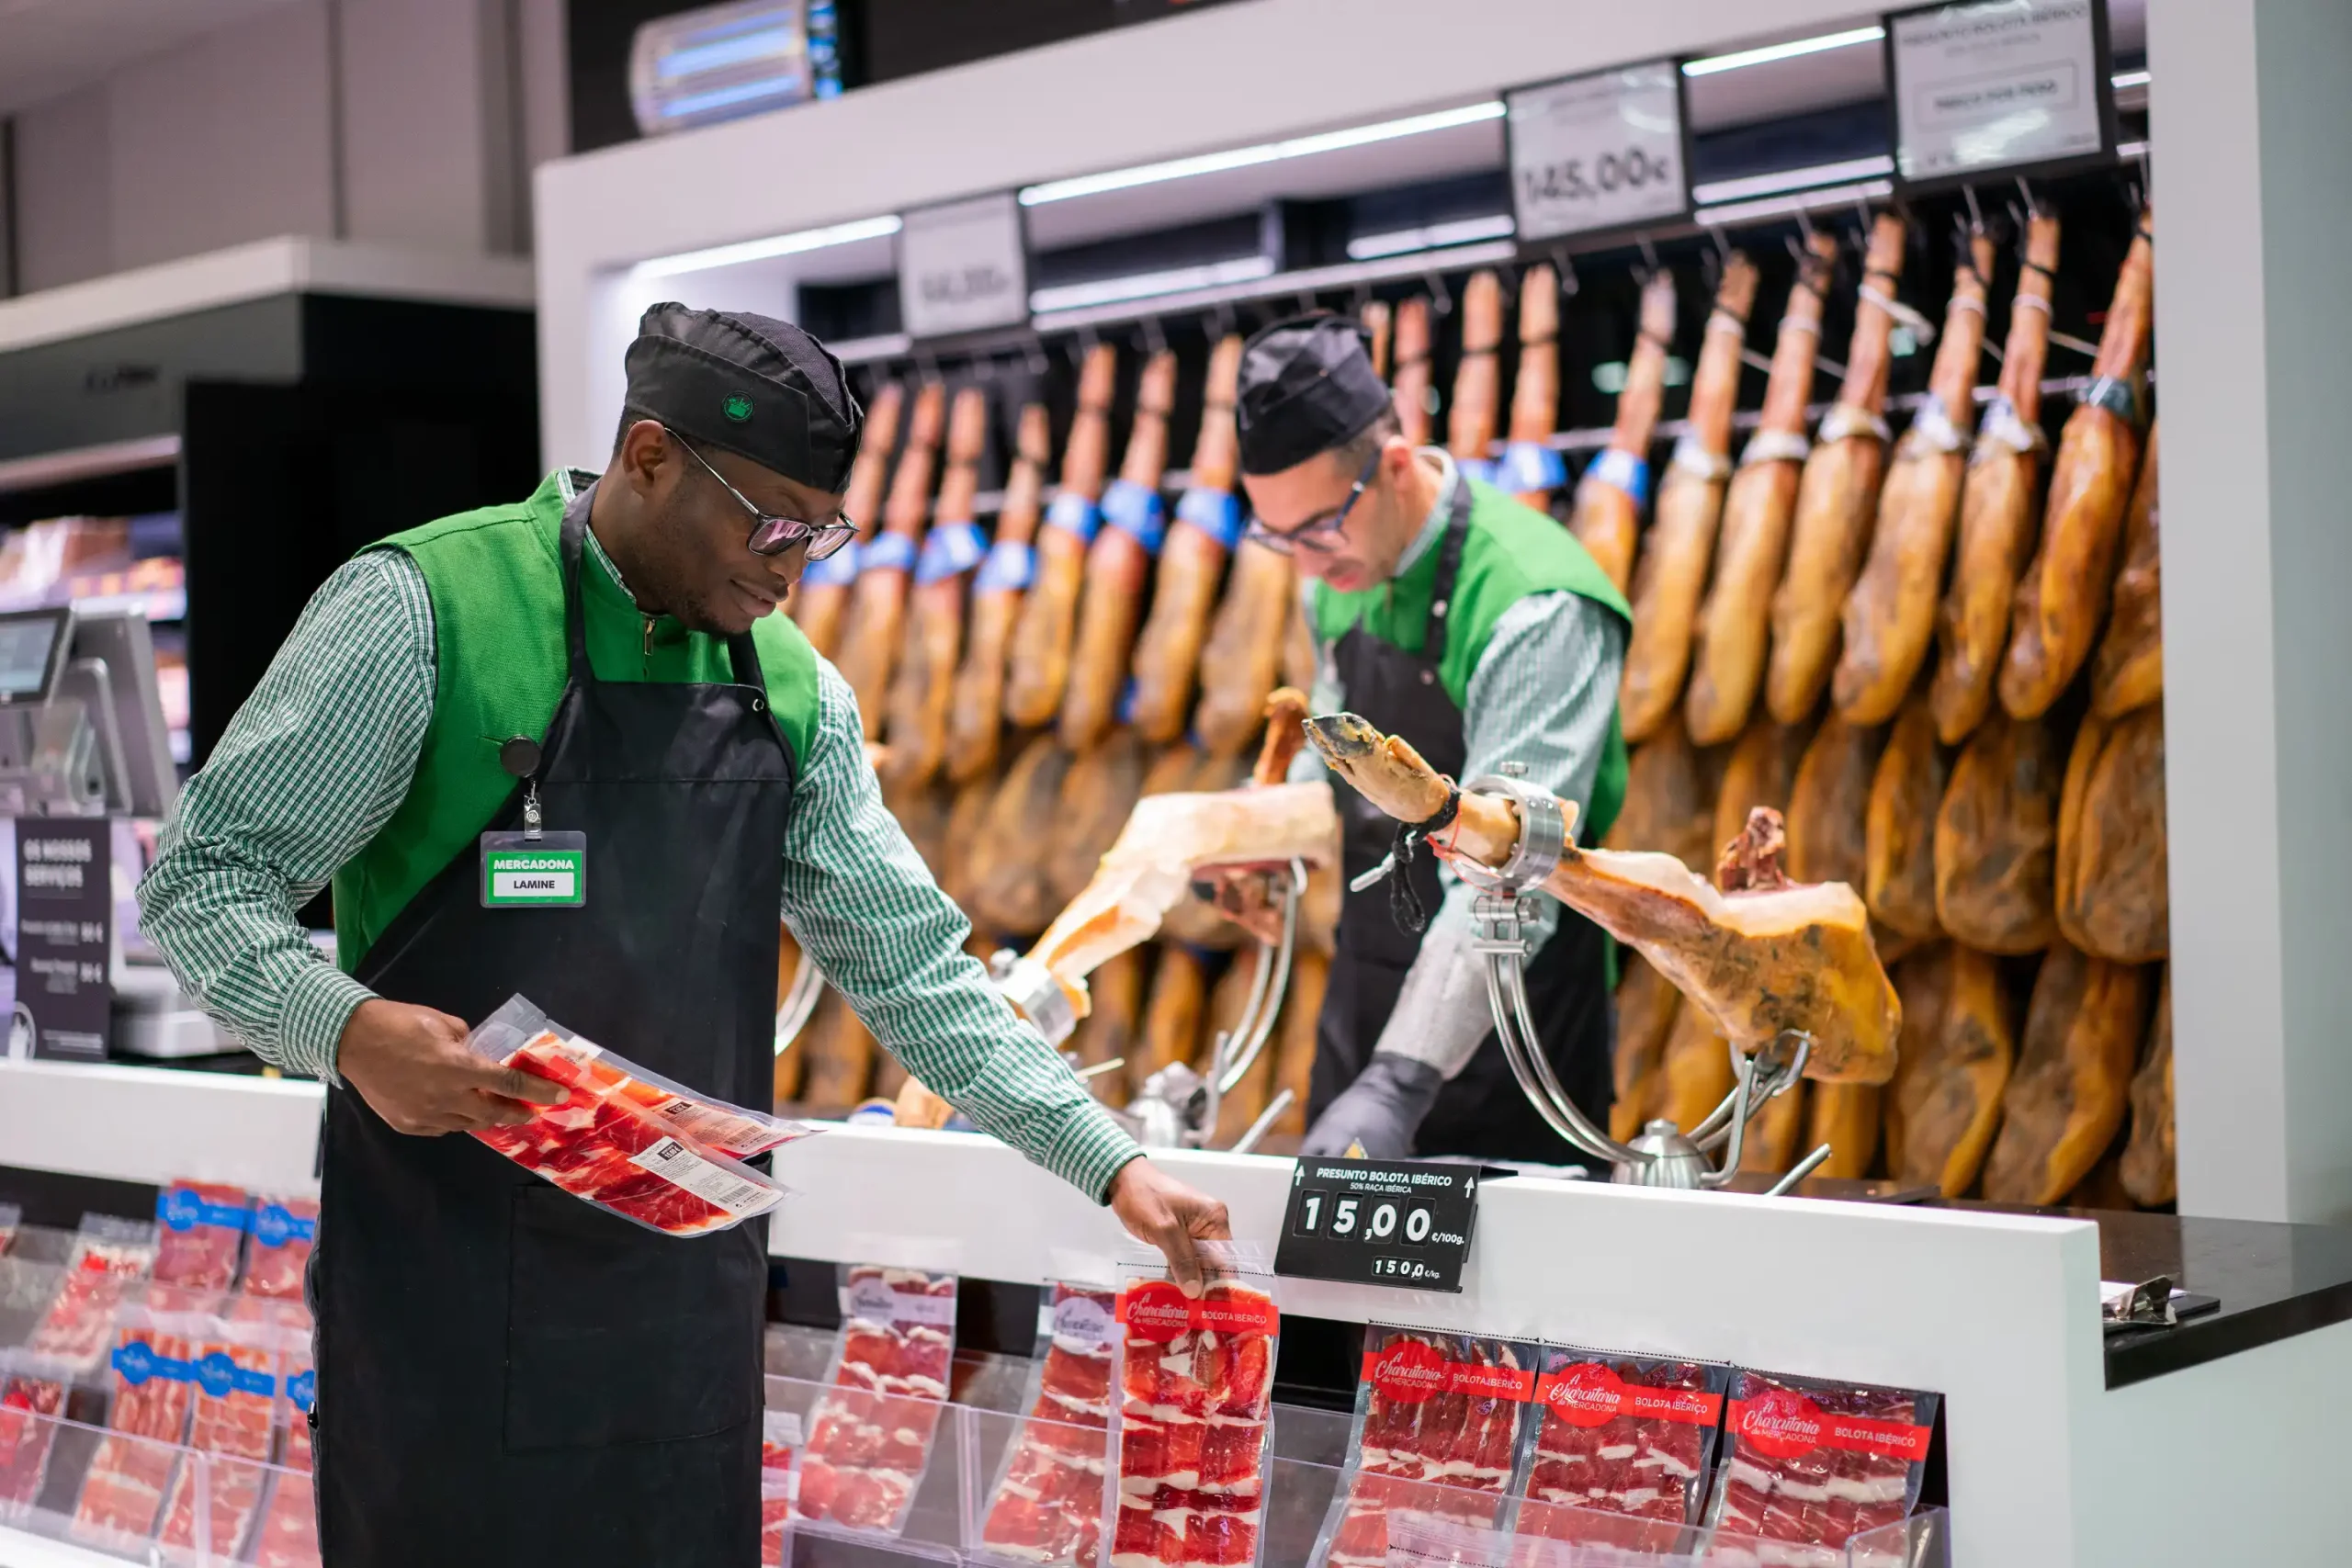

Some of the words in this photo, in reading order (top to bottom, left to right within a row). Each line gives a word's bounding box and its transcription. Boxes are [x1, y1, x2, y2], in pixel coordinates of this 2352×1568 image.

[493, 859, 574, 870] MERCADONA
[514, 880, 555, 889] LAMINE
[1317, 1168, 1367, 1181] PRESUNTO
[1369, 1171, 1409, 1184] BOLOTA
[1411, 1173, 1453, 1187] IBÉRICO
[1350, 1182, 1363, 1190] 50%
[1364, 1183, 1385, 1192] RAÇA
[1385, 1184, 1412, 1193] IBÉRICA
[1201, 1310, 1234, 1321] BOLOTA
[1374, 1359, 1443, 1381] Charcutaria
[1390, 1378, 1438, 1390] MERCADONA
[1453, 1373, 1486, 1385] BOLOTA
[1570, 1373, 1580, 1385] A
[1549, 1383, 1622, 1404] Charcutaria
[1566, 1401, 1617, 1413] MERCADONA
[1635, 1396, 1671, 1409] BOLOTA
[1762, 1401, 1776, 1412] A
[1743, 1410, 1821, 1436] Charcutaria
[1761, 1429, 1817, 1445] MERCADONA
[1835, 1427, 1874, 1441] BOLOTA
